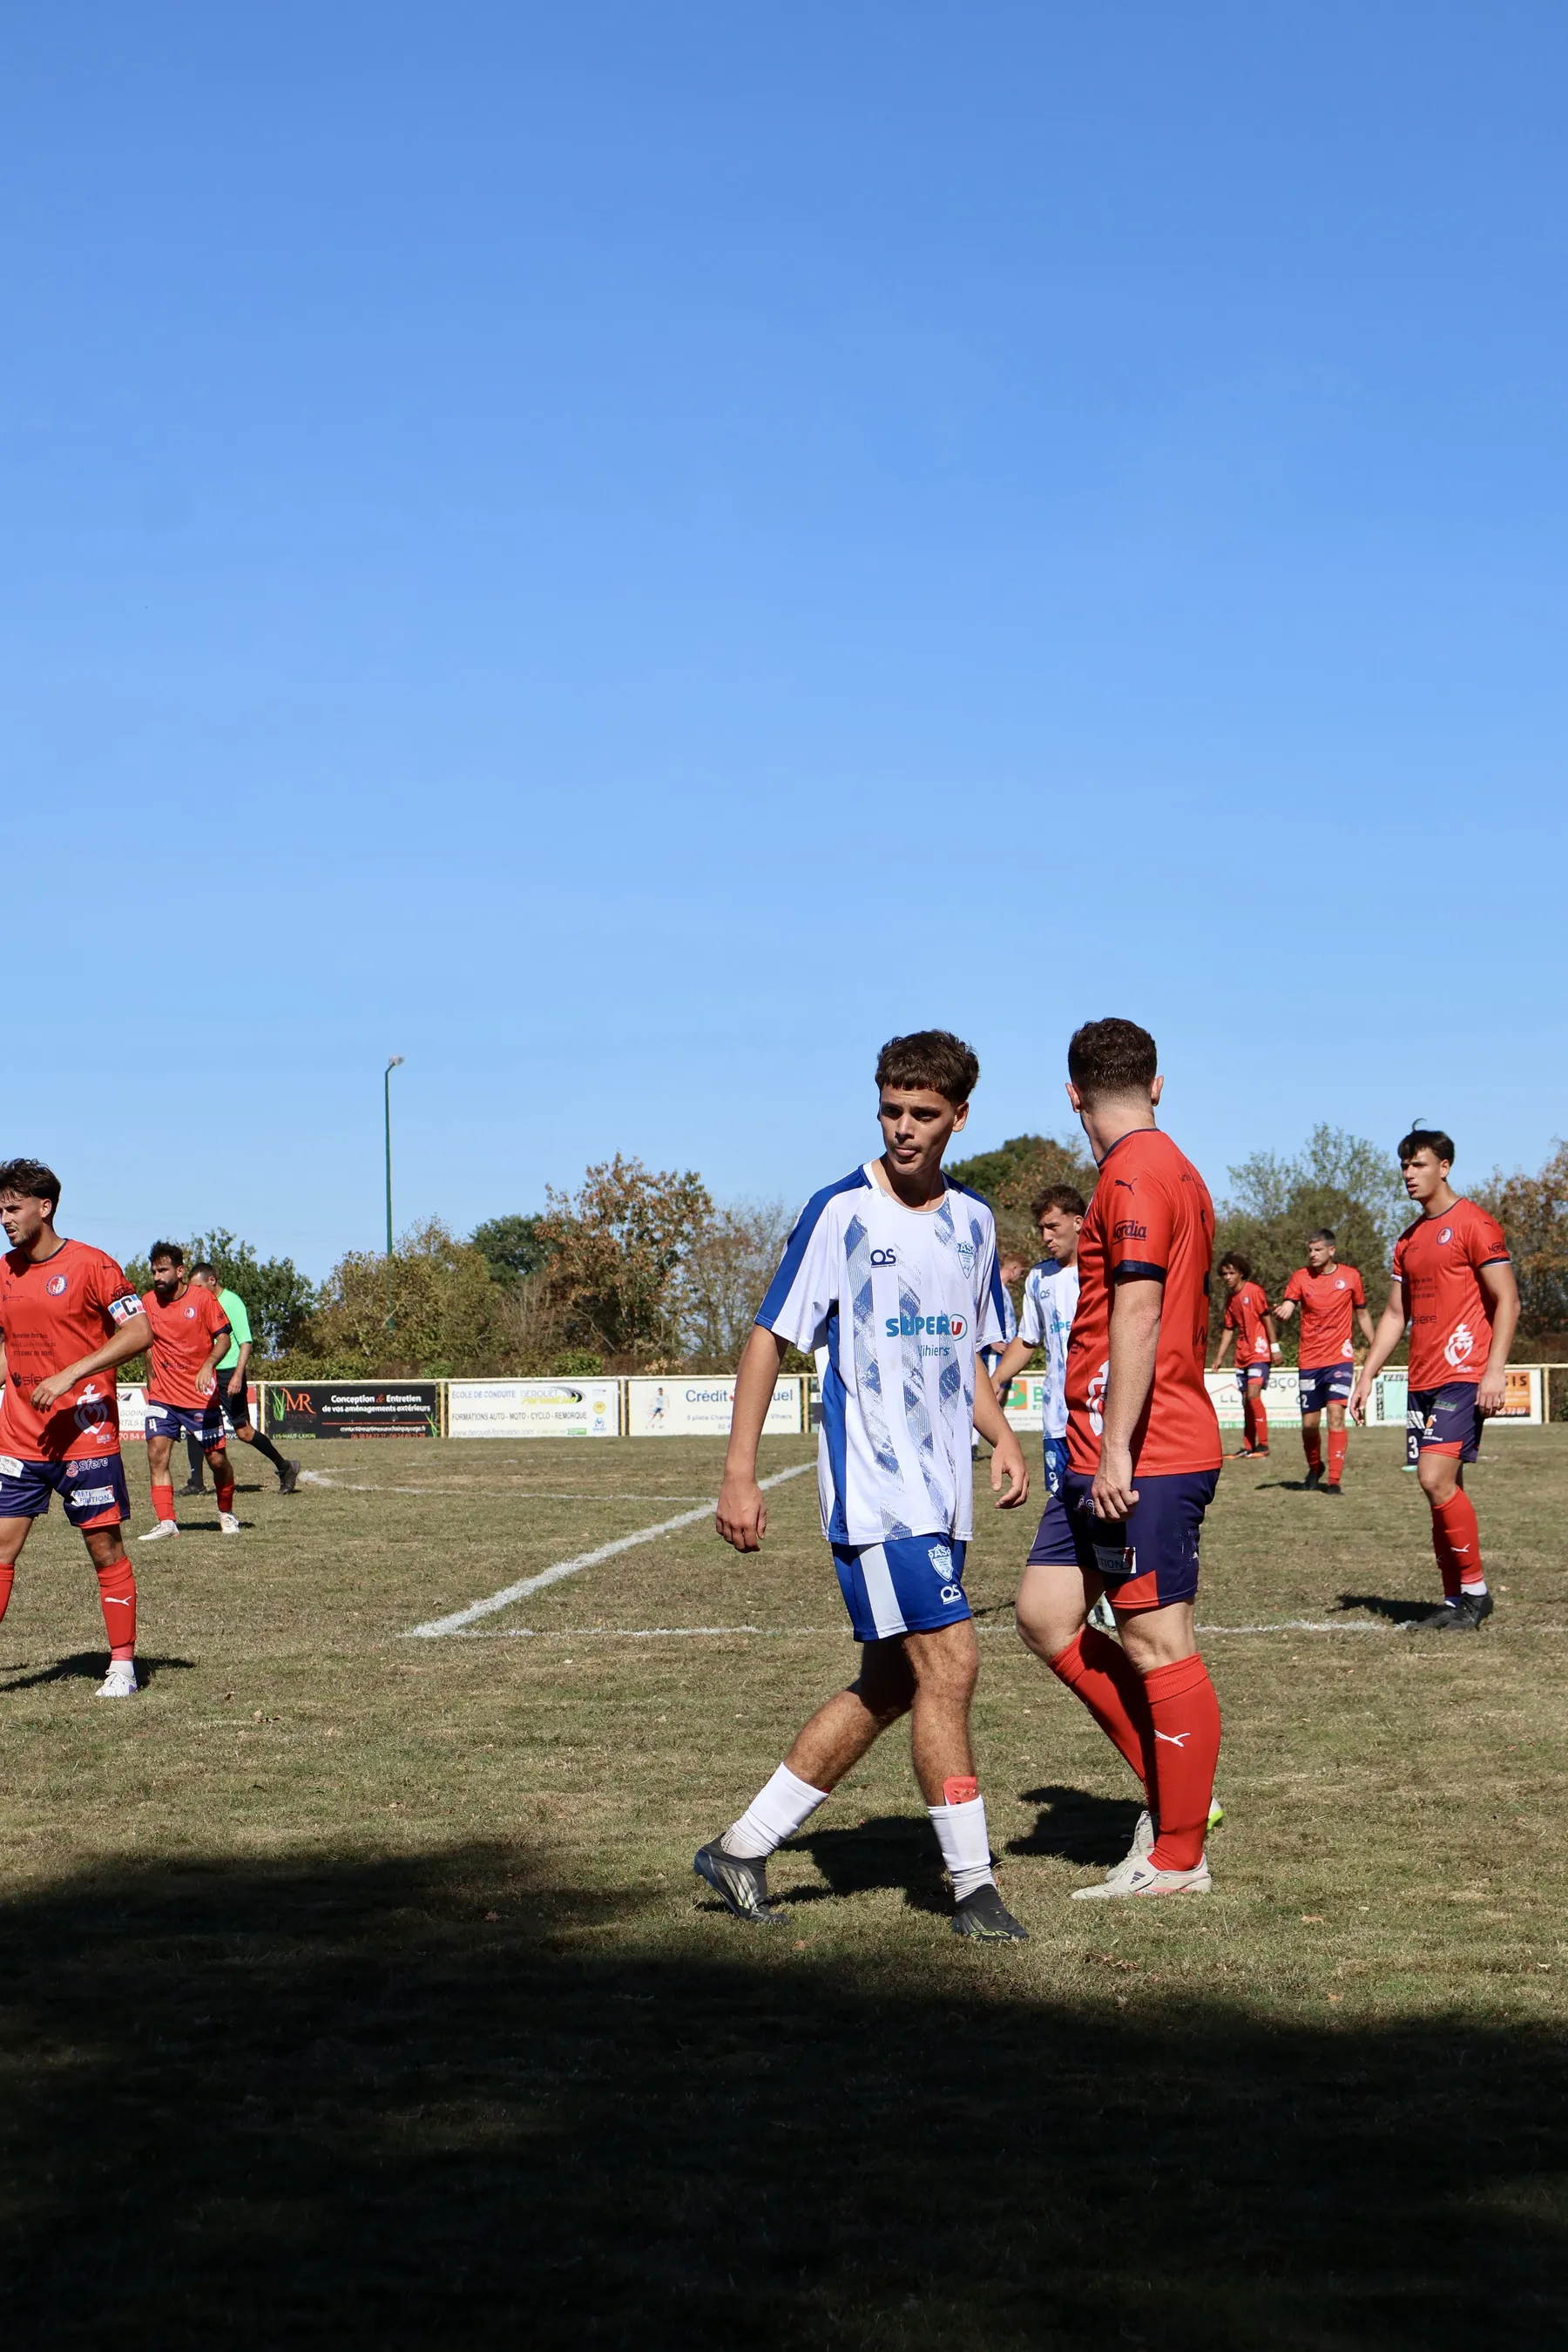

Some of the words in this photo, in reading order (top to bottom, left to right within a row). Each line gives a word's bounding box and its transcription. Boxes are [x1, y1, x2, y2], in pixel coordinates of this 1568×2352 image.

[243, 1220, 276, 1240] ordia
[121, 1297, 137, 1315] C
[885, 1316, 950, 1338] SUPER
[1050, 1321, 1071, 1334] SUPE
[280, 1387, 317, 1415] MR
[331, 1394, 375, 1404] Conception
[375, 1394, 384, 1403] &
[386, 1394, 422, 1403] Entretien
[686, 1389, 728, 1402] Crédit
[773, 1389, 794, 1402] uel
[345, 1404, 396, 1414] aménagements
[396, 1403, 431, 1413] extérieurs
[490, 1412, 505, 1421] AUTO
[510, 1412, 526, 1421] MOTO
[530, 1412, 551, 1421] CYCLO
[554, 1411, 587, 1420] REMORQUE
[148, 1418, 158, 1432] 4
[1408, 1435, 1419, 1459] 3
[78, 1458, 109, 1471] Sfere
[1098, 1558, 1124, 1569] ITION
